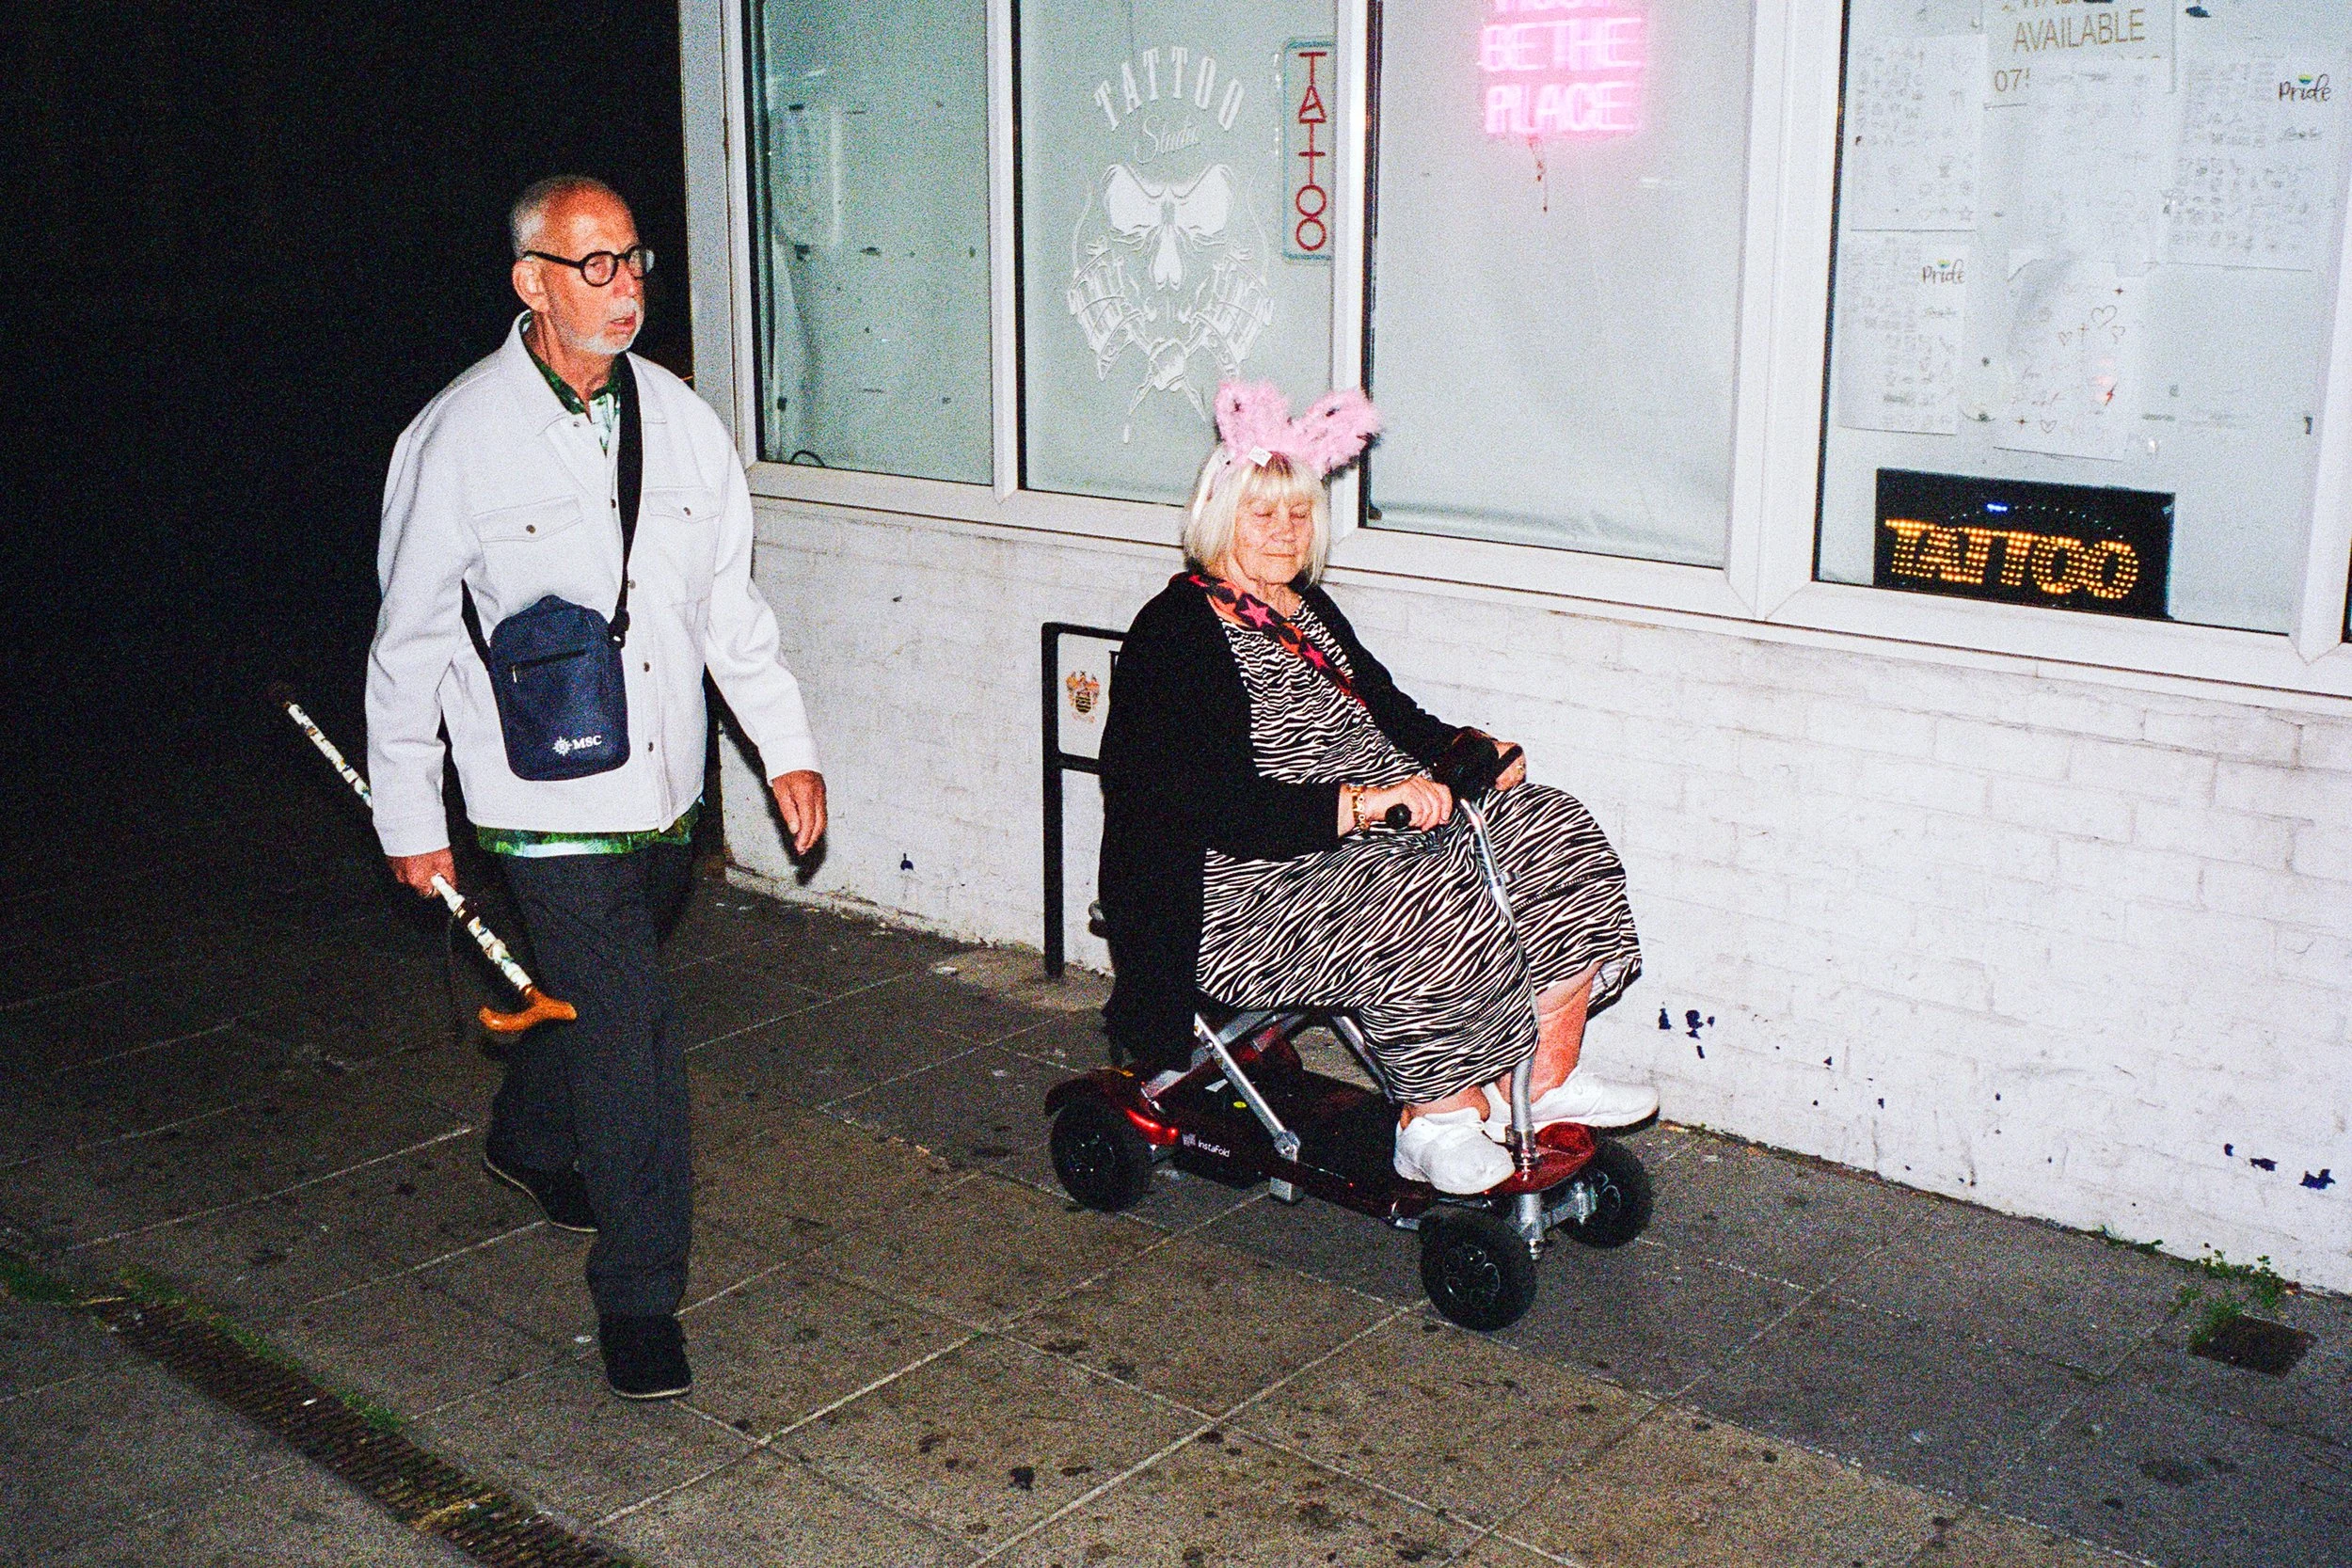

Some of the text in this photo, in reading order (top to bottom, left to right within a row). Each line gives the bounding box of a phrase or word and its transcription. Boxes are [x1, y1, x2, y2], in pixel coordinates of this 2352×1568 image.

[1481, 17, 1644, 71] BE THE
[2011, 8, 2146, 54] AVAILABLE
[1093, 46, 1246, 132] TATTOO
[1994, 67, 2030, 92] 07
[2278, 73, 2332, 103] Pride
[1484, 81, 1640, 135] PLACE
[1295, 51, 1327, 251] TATTOO
[1921, 259, 1965, 285] Pride
[1884, 518, 2139, 599] TATTOO
[572, 735, 602, 751] MSC
